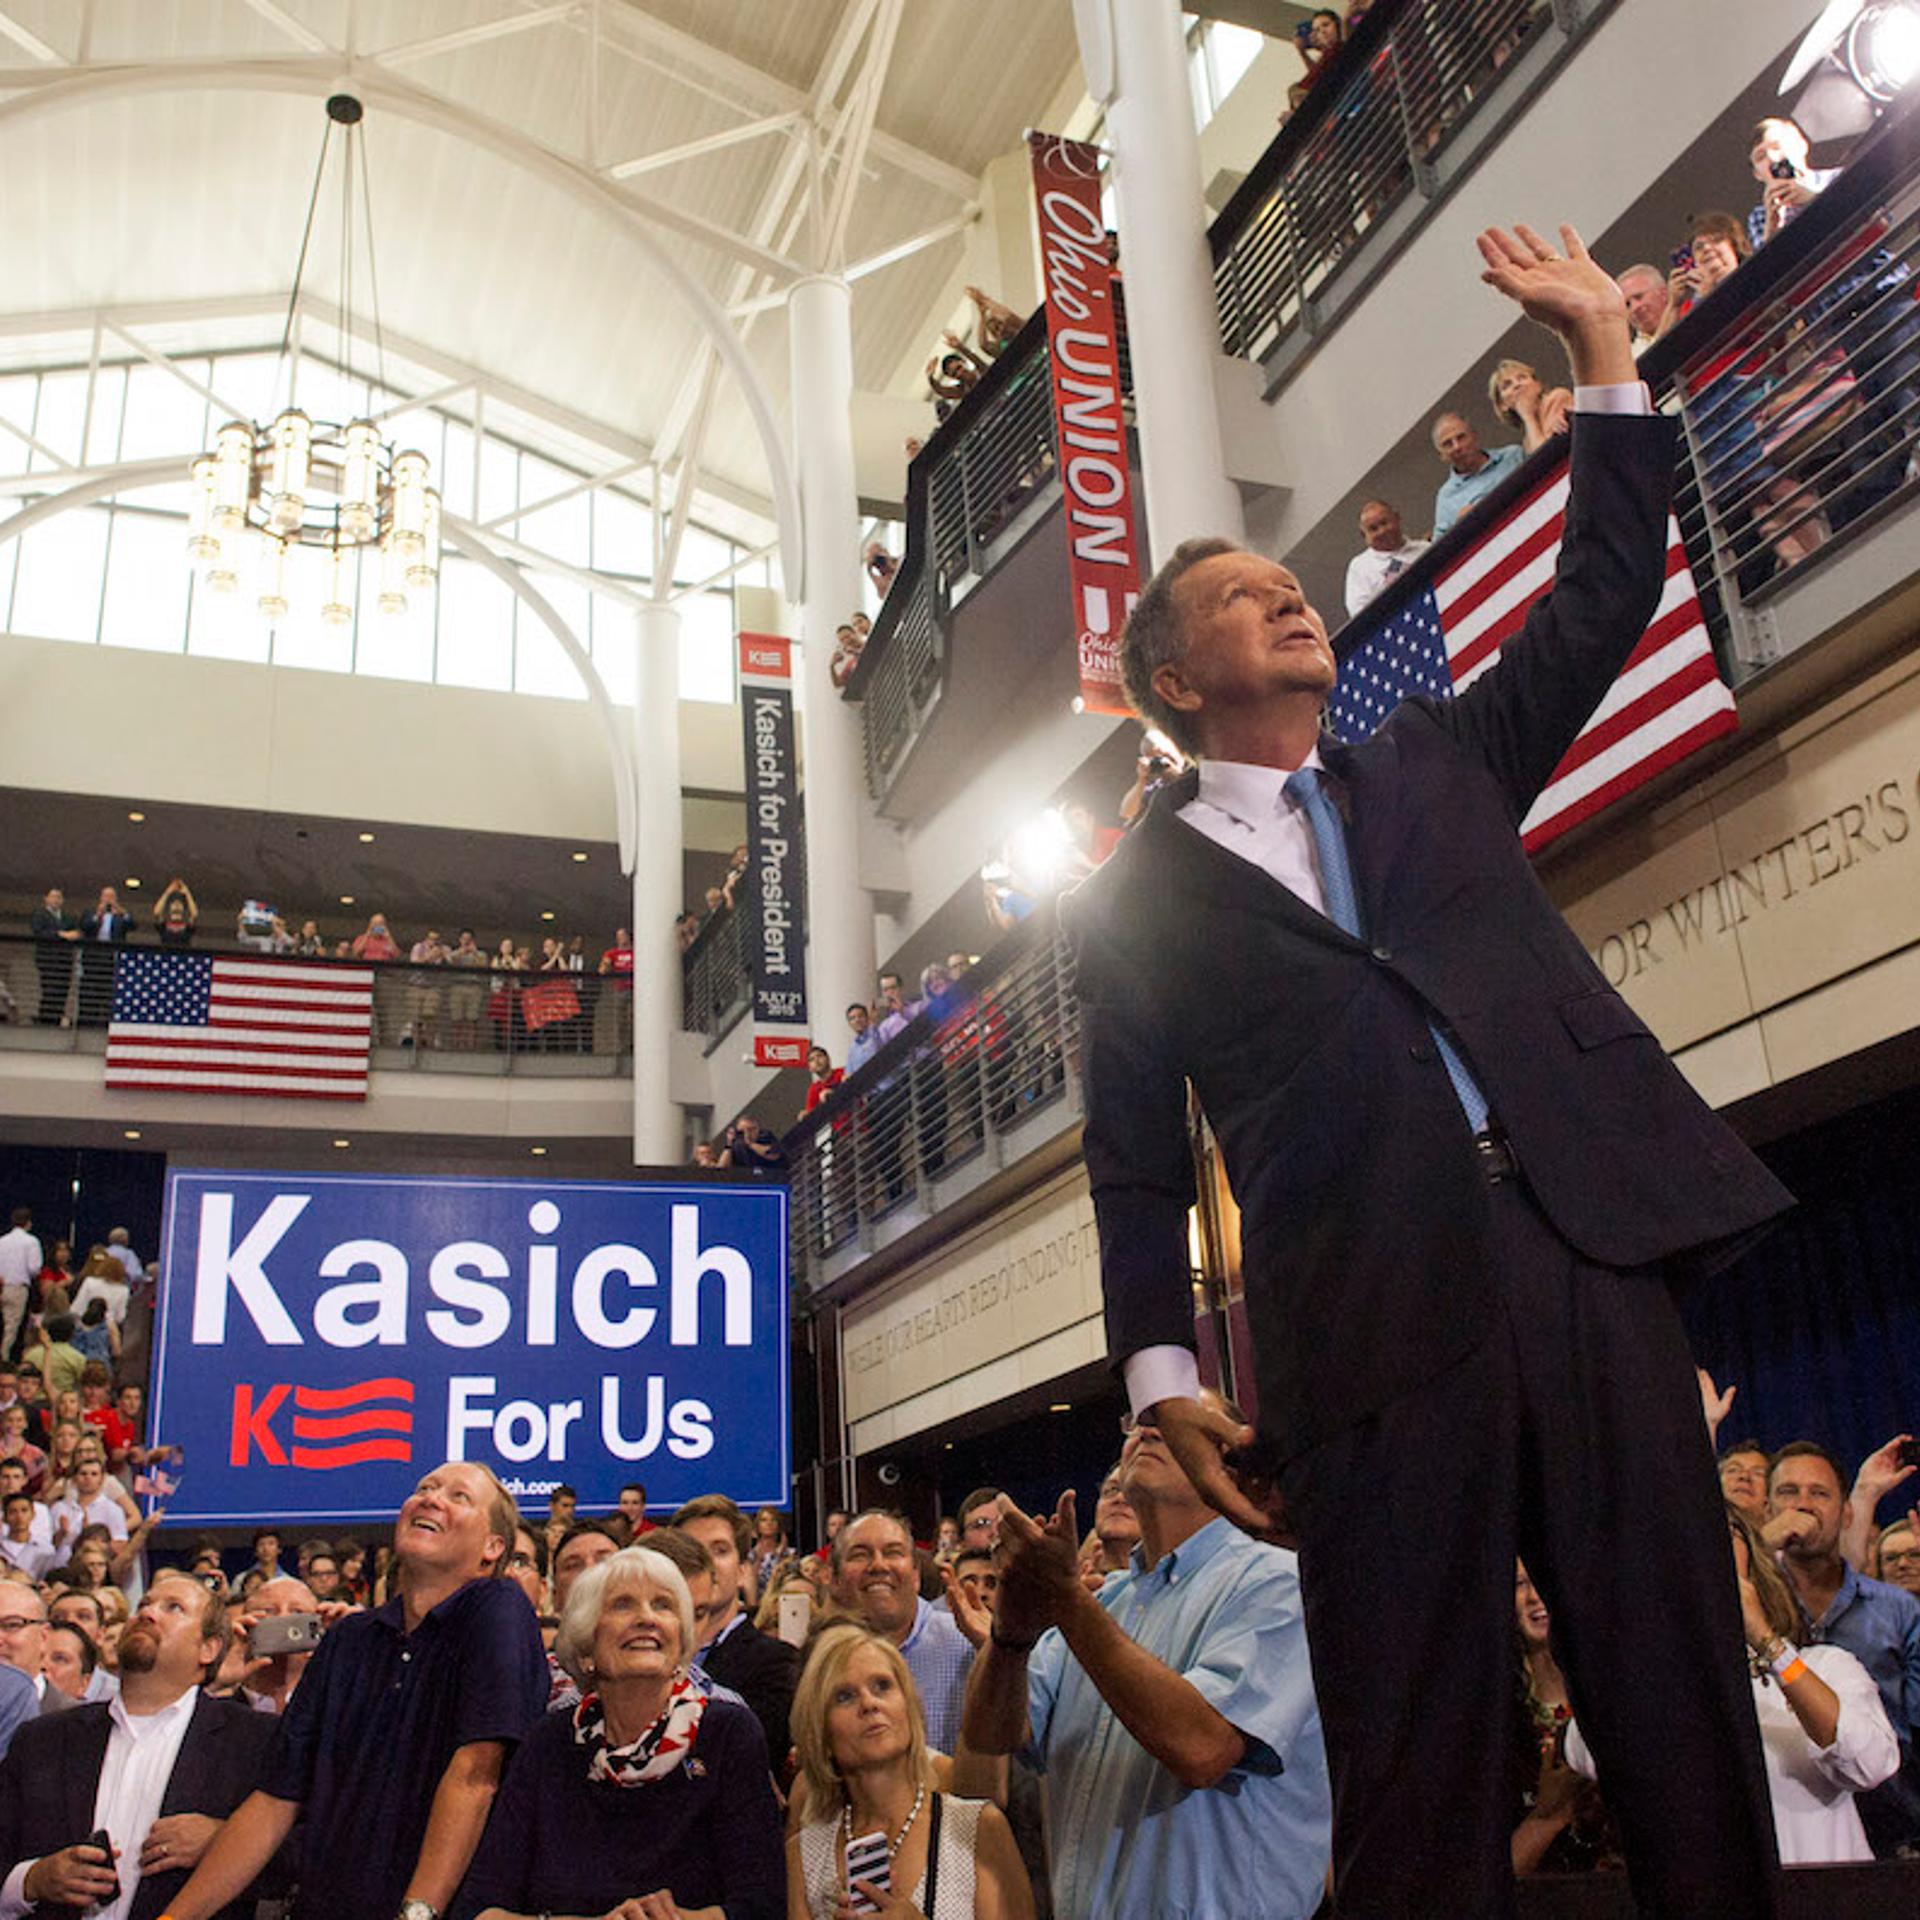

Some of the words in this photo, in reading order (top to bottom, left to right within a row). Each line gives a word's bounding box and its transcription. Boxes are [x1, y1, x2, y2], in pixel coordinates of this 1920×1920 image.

[1042, 190, 1111, 318] Ohio
[1056, 326, 1130, 566] UNION
[1079, 649, 1120, 667] UNI
[754, 698, 786, 787] Kasich
[758, 794, 788, 832] for
[761, 838, 791, 975] President
[1597, 920, 1662, 987] OR
[1664, 779, 1910, 948] WINTER'S
[191, 1192, 753, 1348] Kasich
[447, 1376, 582, 1462] For
[601, 1376, 715, 1461] Us
